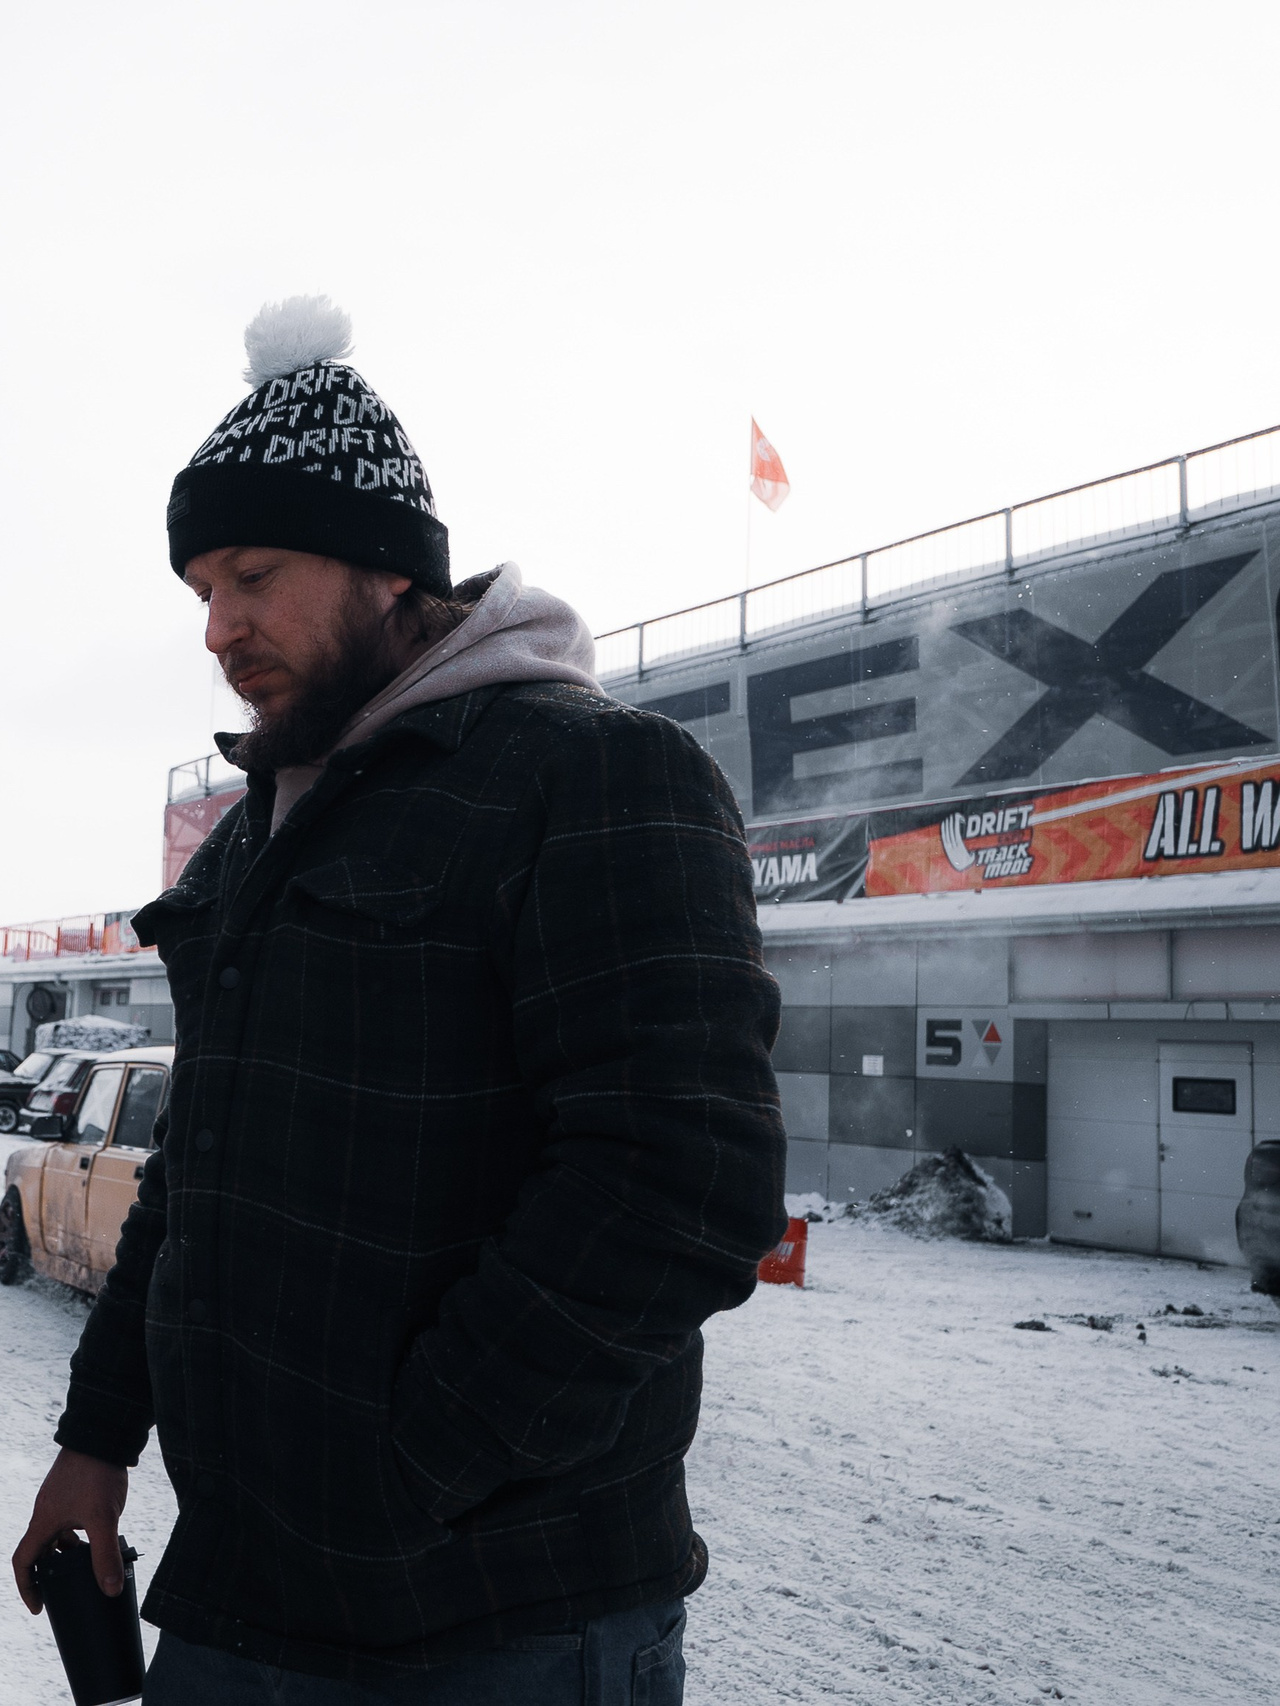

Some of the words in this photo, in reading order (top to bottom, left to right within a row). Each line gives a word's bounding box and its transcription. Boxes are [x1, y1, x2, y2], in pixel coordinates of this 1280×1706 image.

[193, 401, 308, 461] DRIFT
[262, 426, 376, 464] DRIFT
[636, 549, 1280, 816] EX
[966, 804, 1034, 838] DRIFT
[1144, 786, 1223, 860] ALL
[977, 842, 1029, 866] TRACK
[984, 857, 1033, 879] MODE
[925, 1019, 963, 1067] 5
